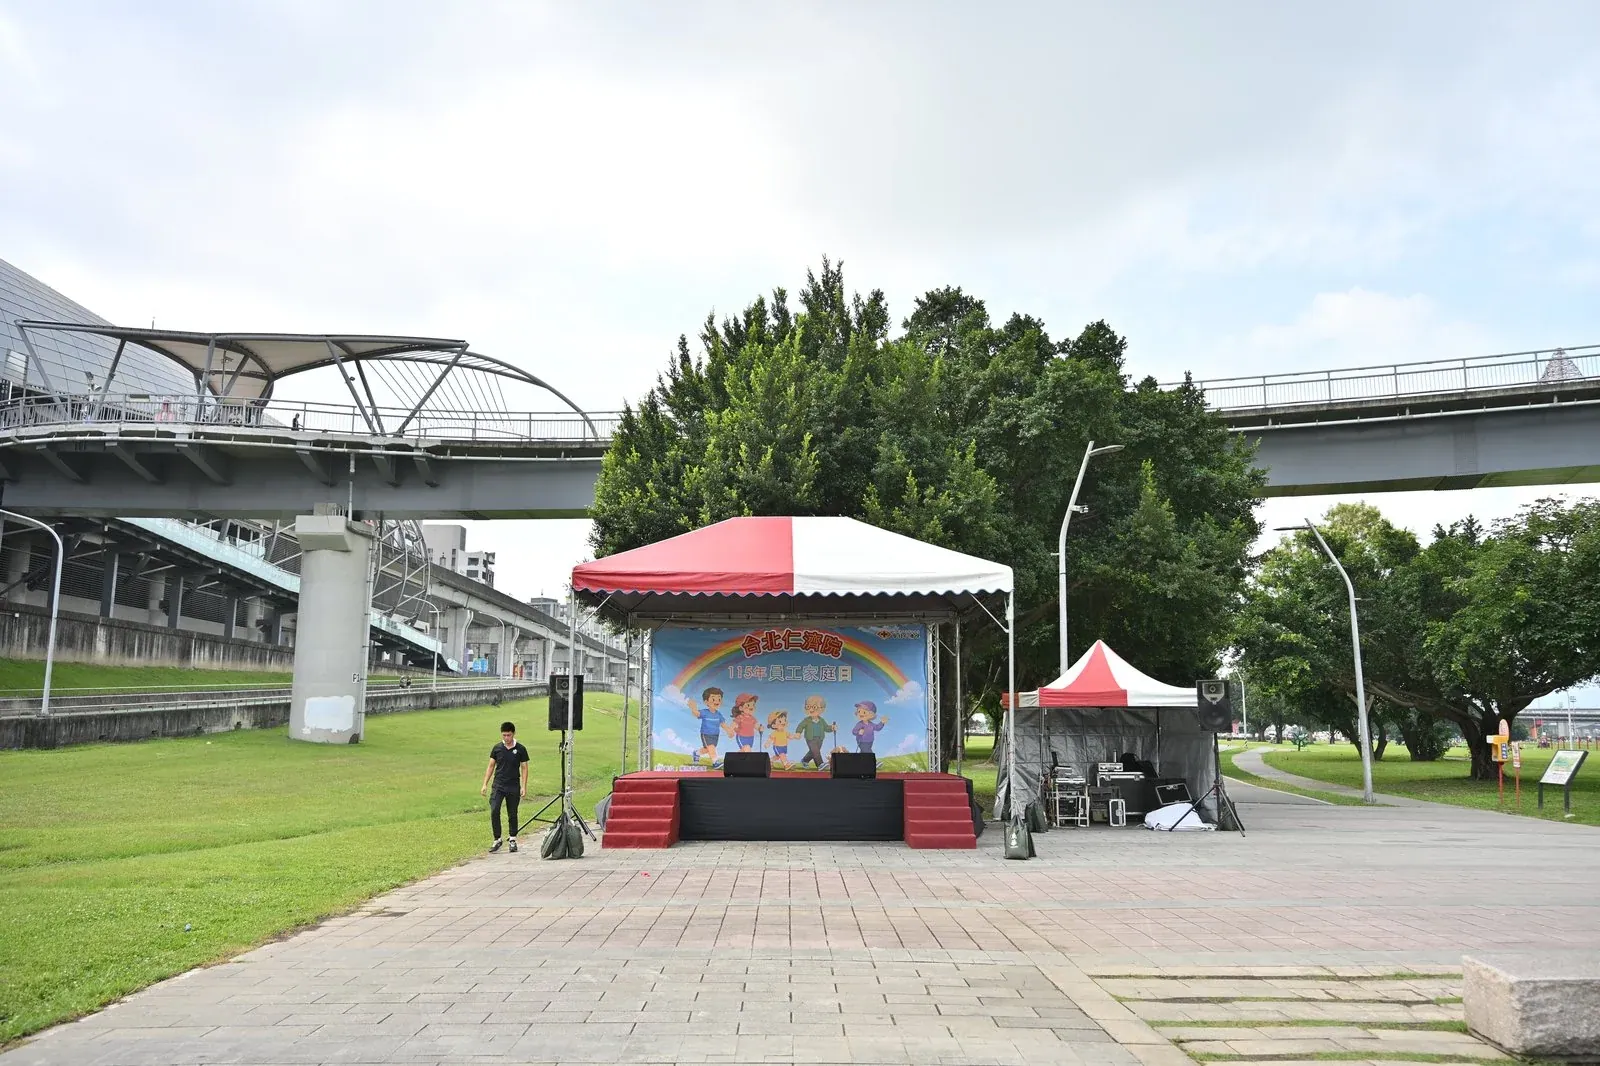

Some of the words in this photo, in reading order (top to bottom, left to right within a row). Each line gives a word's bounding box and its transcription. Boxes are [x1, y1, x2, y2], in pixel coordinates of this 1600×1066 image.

[741, 628, 843, 658] 台北仁濟院
[727, 664, 852, 681] 115年員工家庭日
